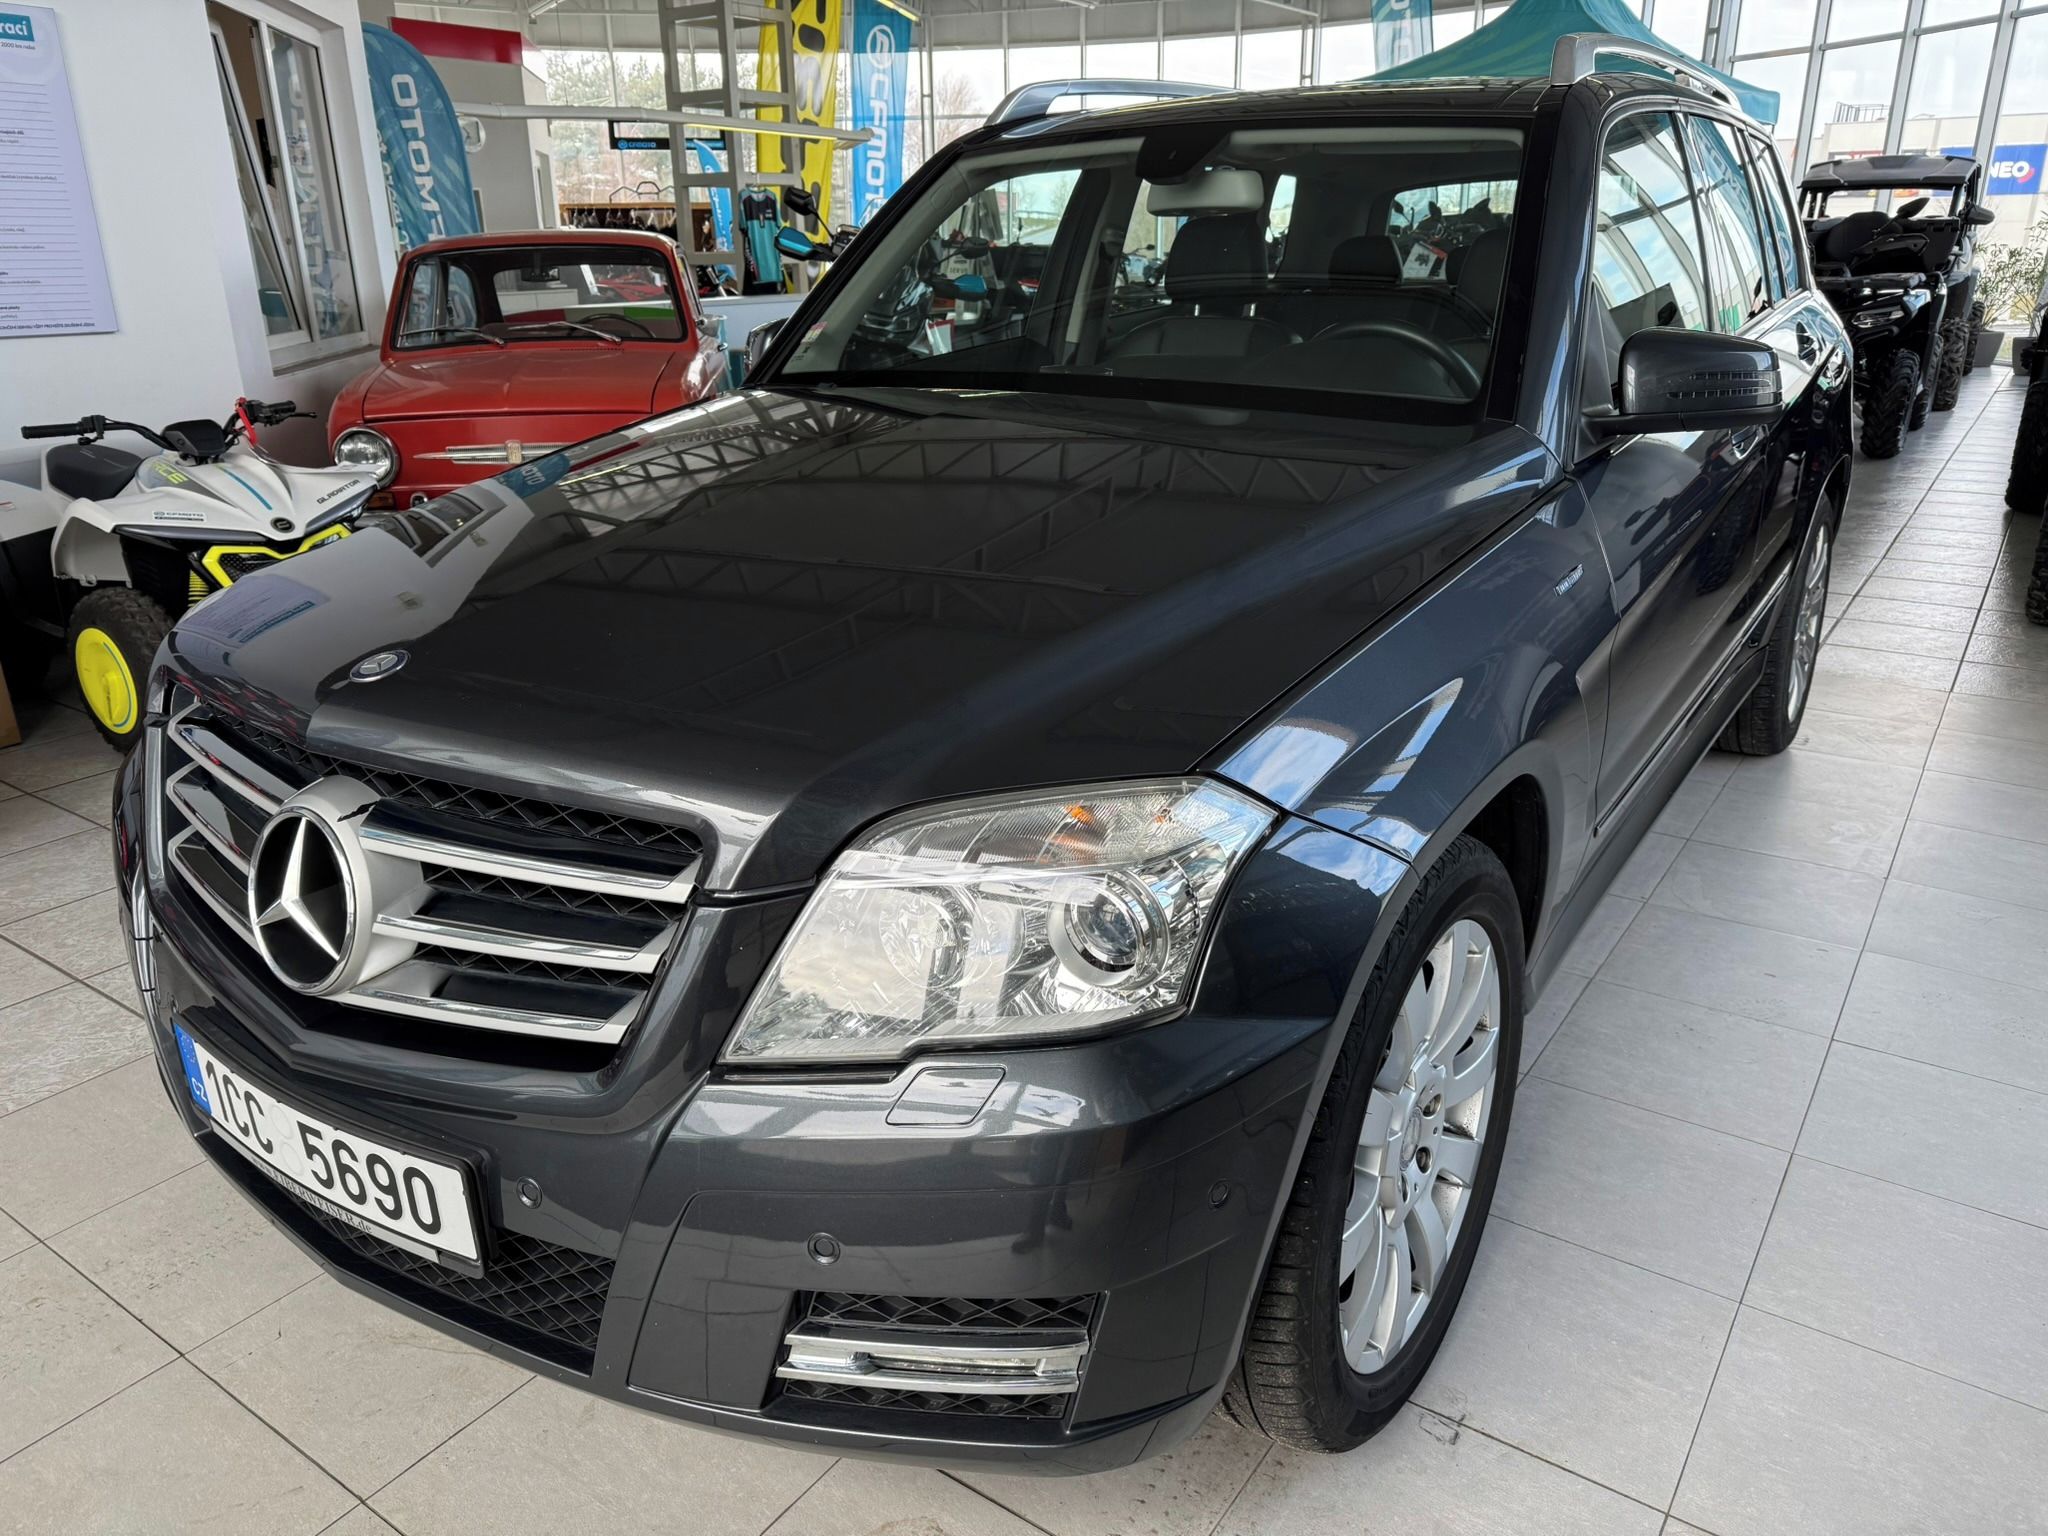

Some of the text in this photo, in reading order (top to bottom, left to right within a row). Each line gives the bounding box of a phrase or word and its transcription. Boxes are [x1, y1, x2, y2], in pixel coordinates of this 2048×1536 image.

[865, 72, 889, 211] CFMOT
[191, 1076, 207, 1102] CZ
[205, 1061, 442, 1235] 1CC 5690
